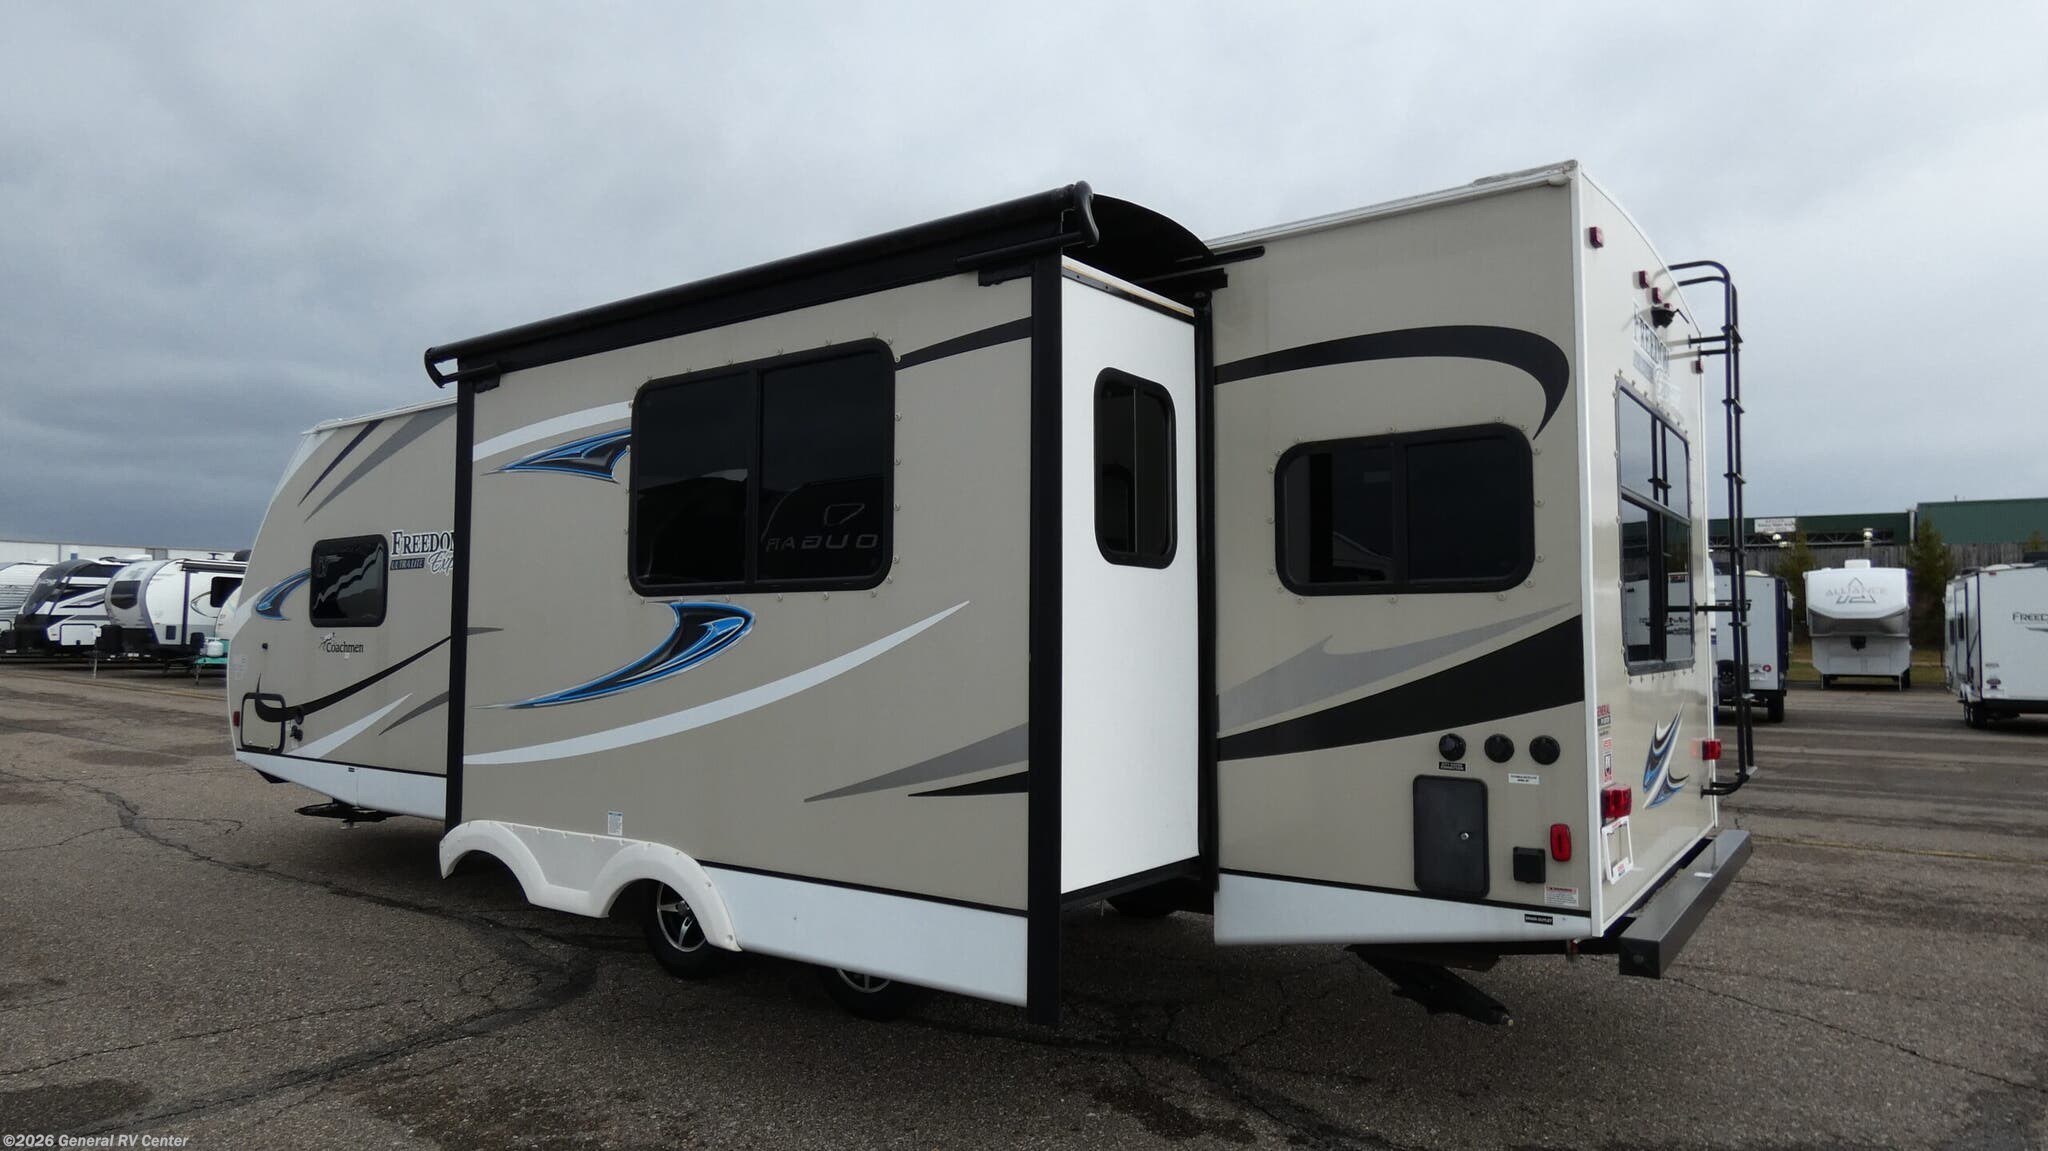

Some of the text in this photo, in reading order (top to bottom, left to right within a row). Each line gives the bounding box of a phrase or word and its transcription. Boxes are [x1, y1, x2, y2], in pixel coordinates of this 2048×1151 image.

[391, 531, 454, 555] FREEDO
[428, 551, 454, 574] Exp
[2012, 612, 2048, 621] FREED
[326, 641, 364, 653] Coachmen
